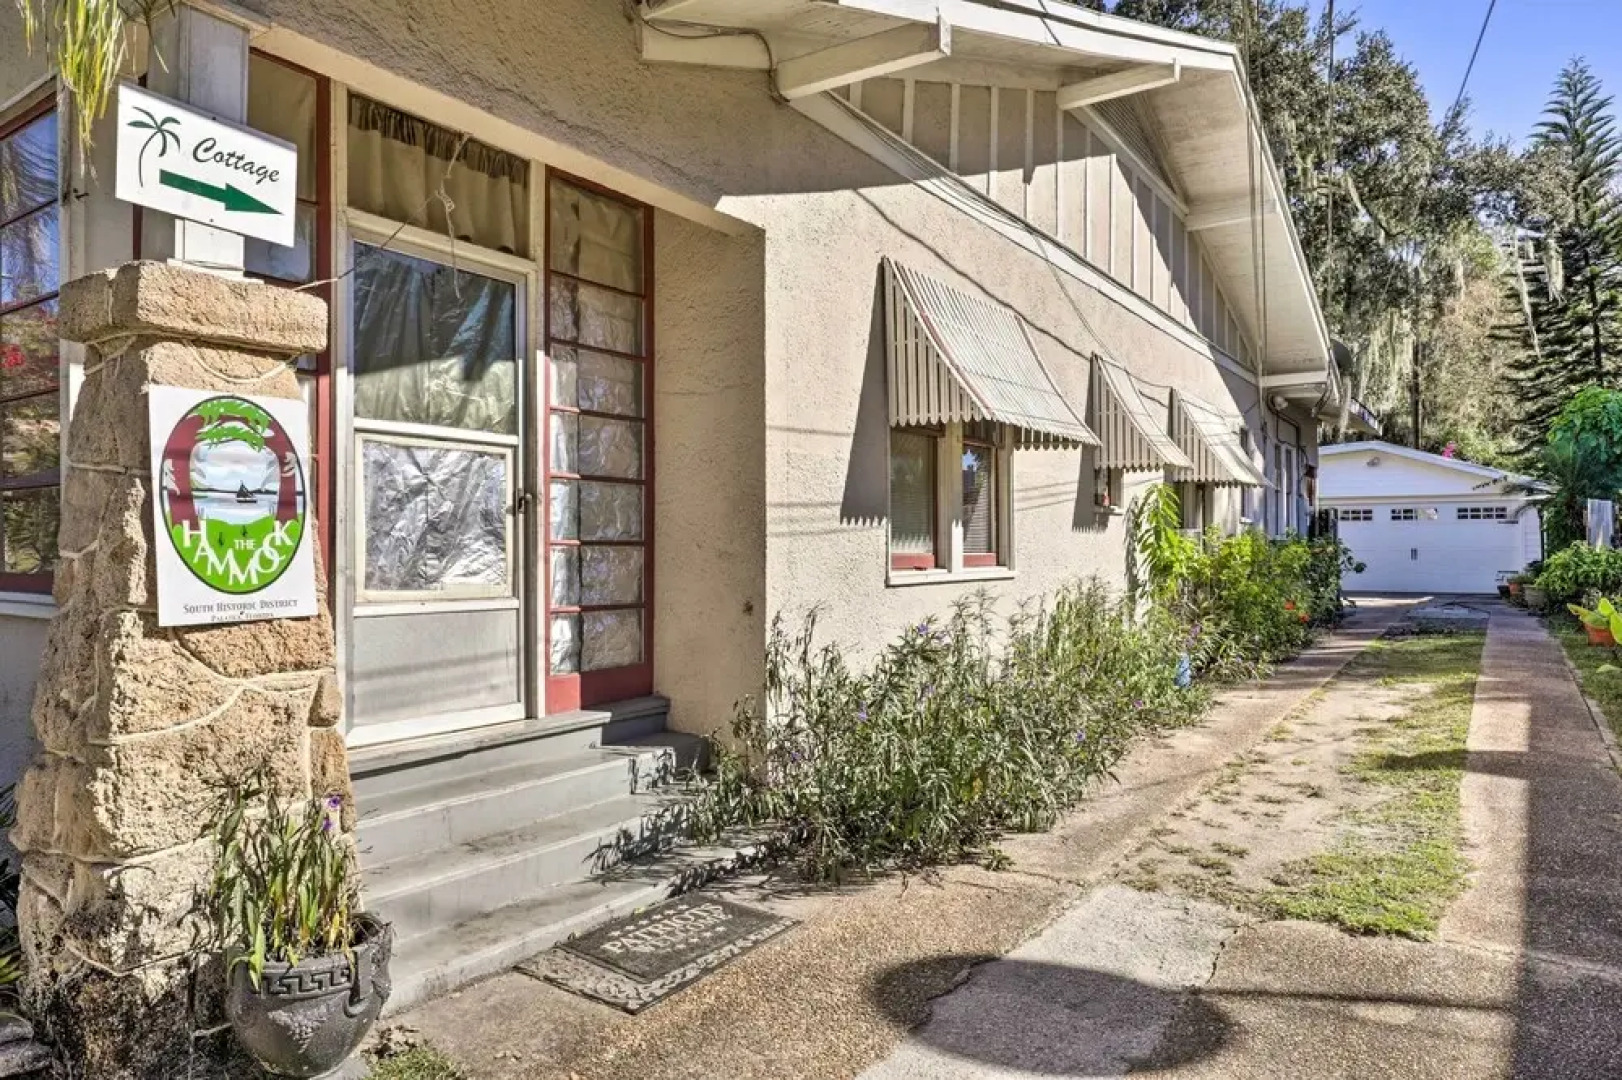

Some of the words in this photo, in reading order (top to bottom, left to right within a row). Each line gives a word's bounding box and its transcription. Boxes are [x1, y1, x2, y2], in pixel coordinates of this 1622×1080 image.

[192, 137, 280, 185] Cottage
[182, 519, 294, 586] HAMMOCK
[234, 539, 256, 551] THE
[600, 903, 723, 953] PATRIOTS
